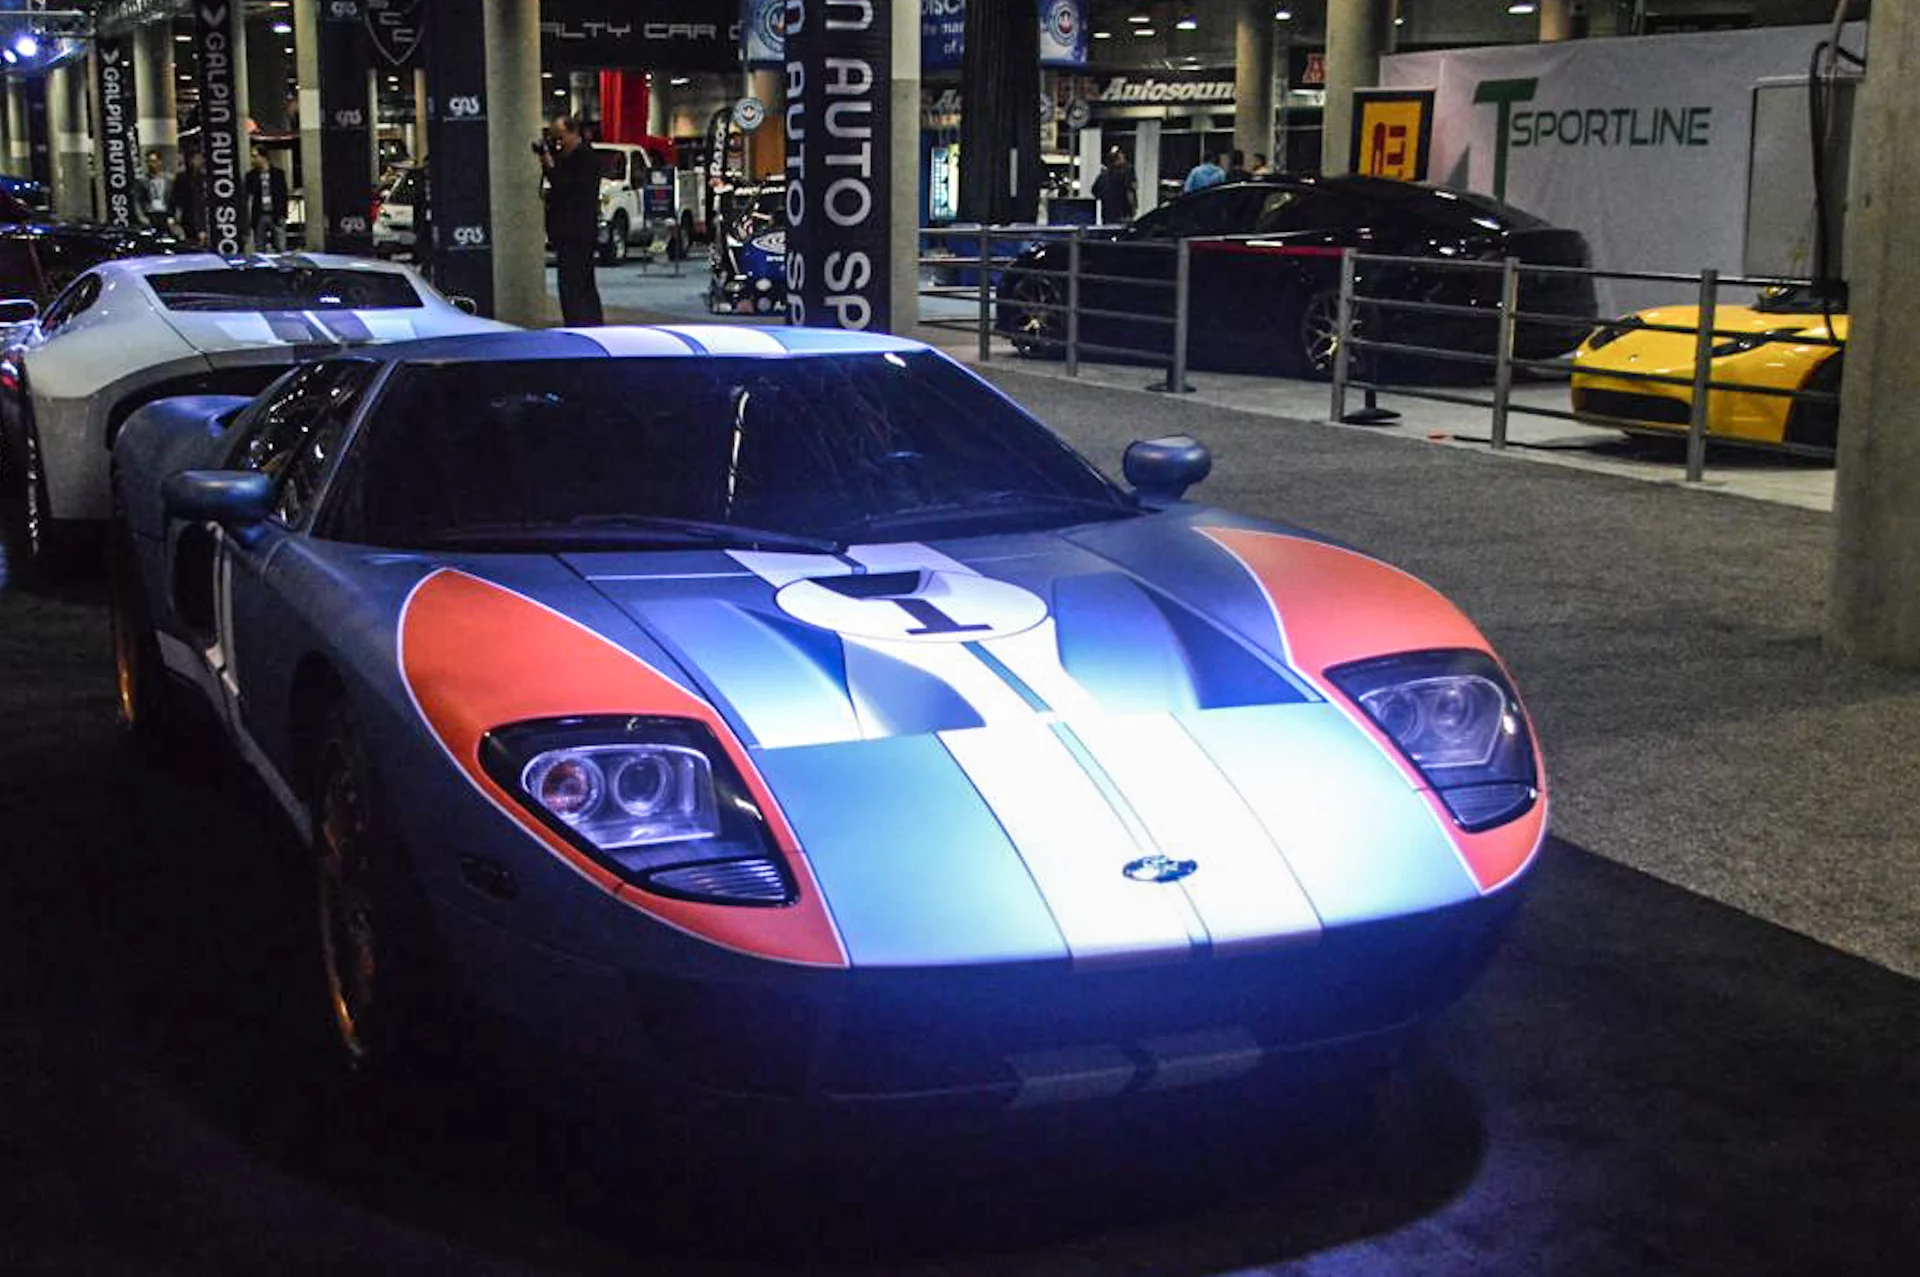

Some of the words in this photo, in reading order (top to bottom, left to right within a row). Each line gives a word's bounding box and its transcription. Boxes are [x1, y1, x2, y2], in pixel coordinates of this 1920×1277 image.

[644, 22, 717, 40] CAR
[1103, 77, 1235, 101] Autosoun
[108, 139, 127, 189] AUTO
[210, 132, 235, 199] AUTO
[786, 61, 805, 228] AUTO
[824, 57, 873, 227] AUTO
[824, 250, 872, 331] SP
